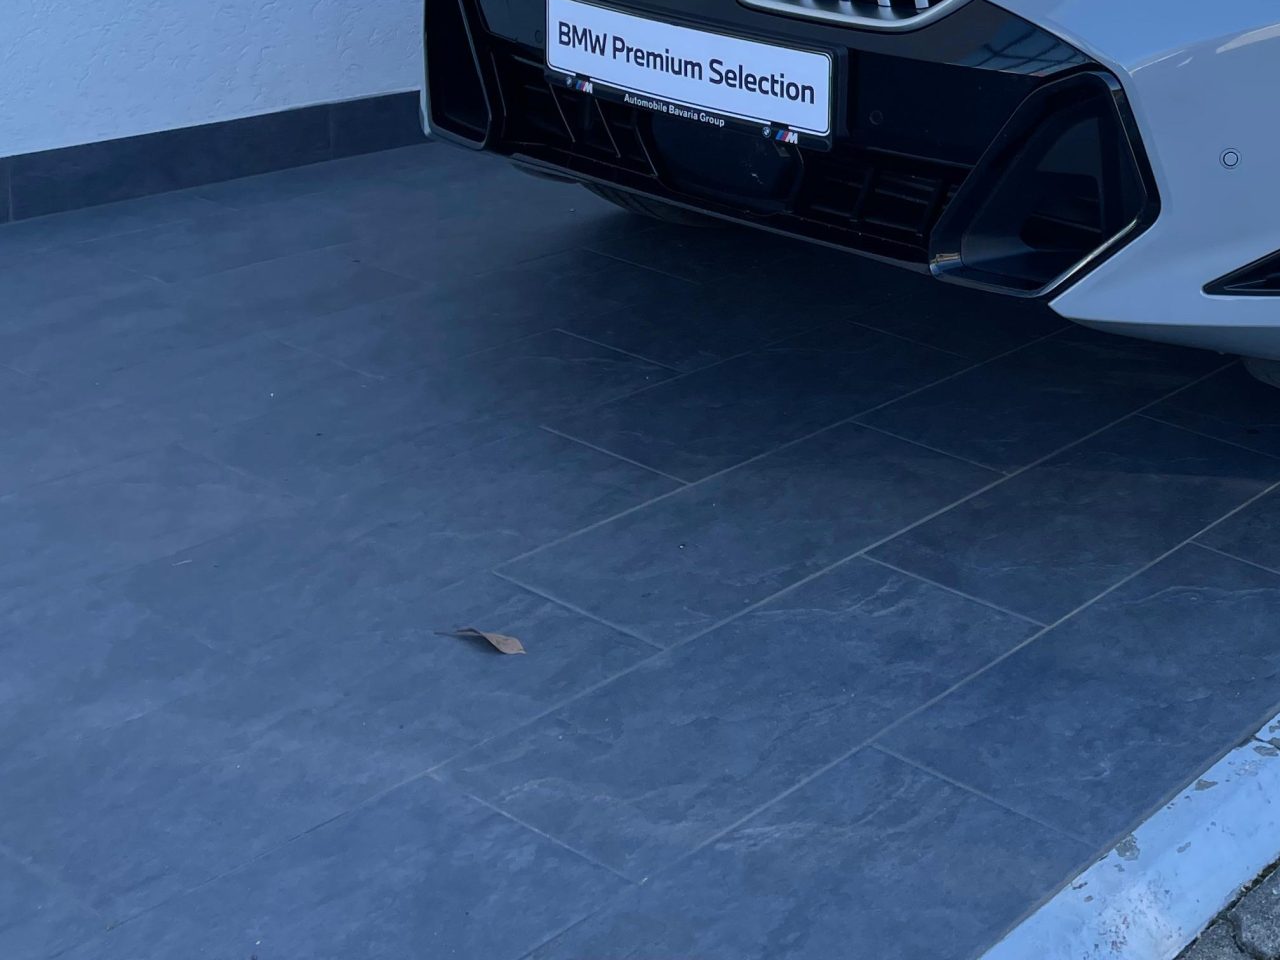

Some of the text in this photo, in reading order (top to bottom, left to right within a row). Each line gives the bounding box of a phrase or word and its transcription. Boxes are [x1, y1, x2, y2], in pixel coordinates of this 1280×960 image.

[558, 21, 815, 105] BMW Premium Selection
[624, 93, 725, 128] Automobile Bavaria Group
